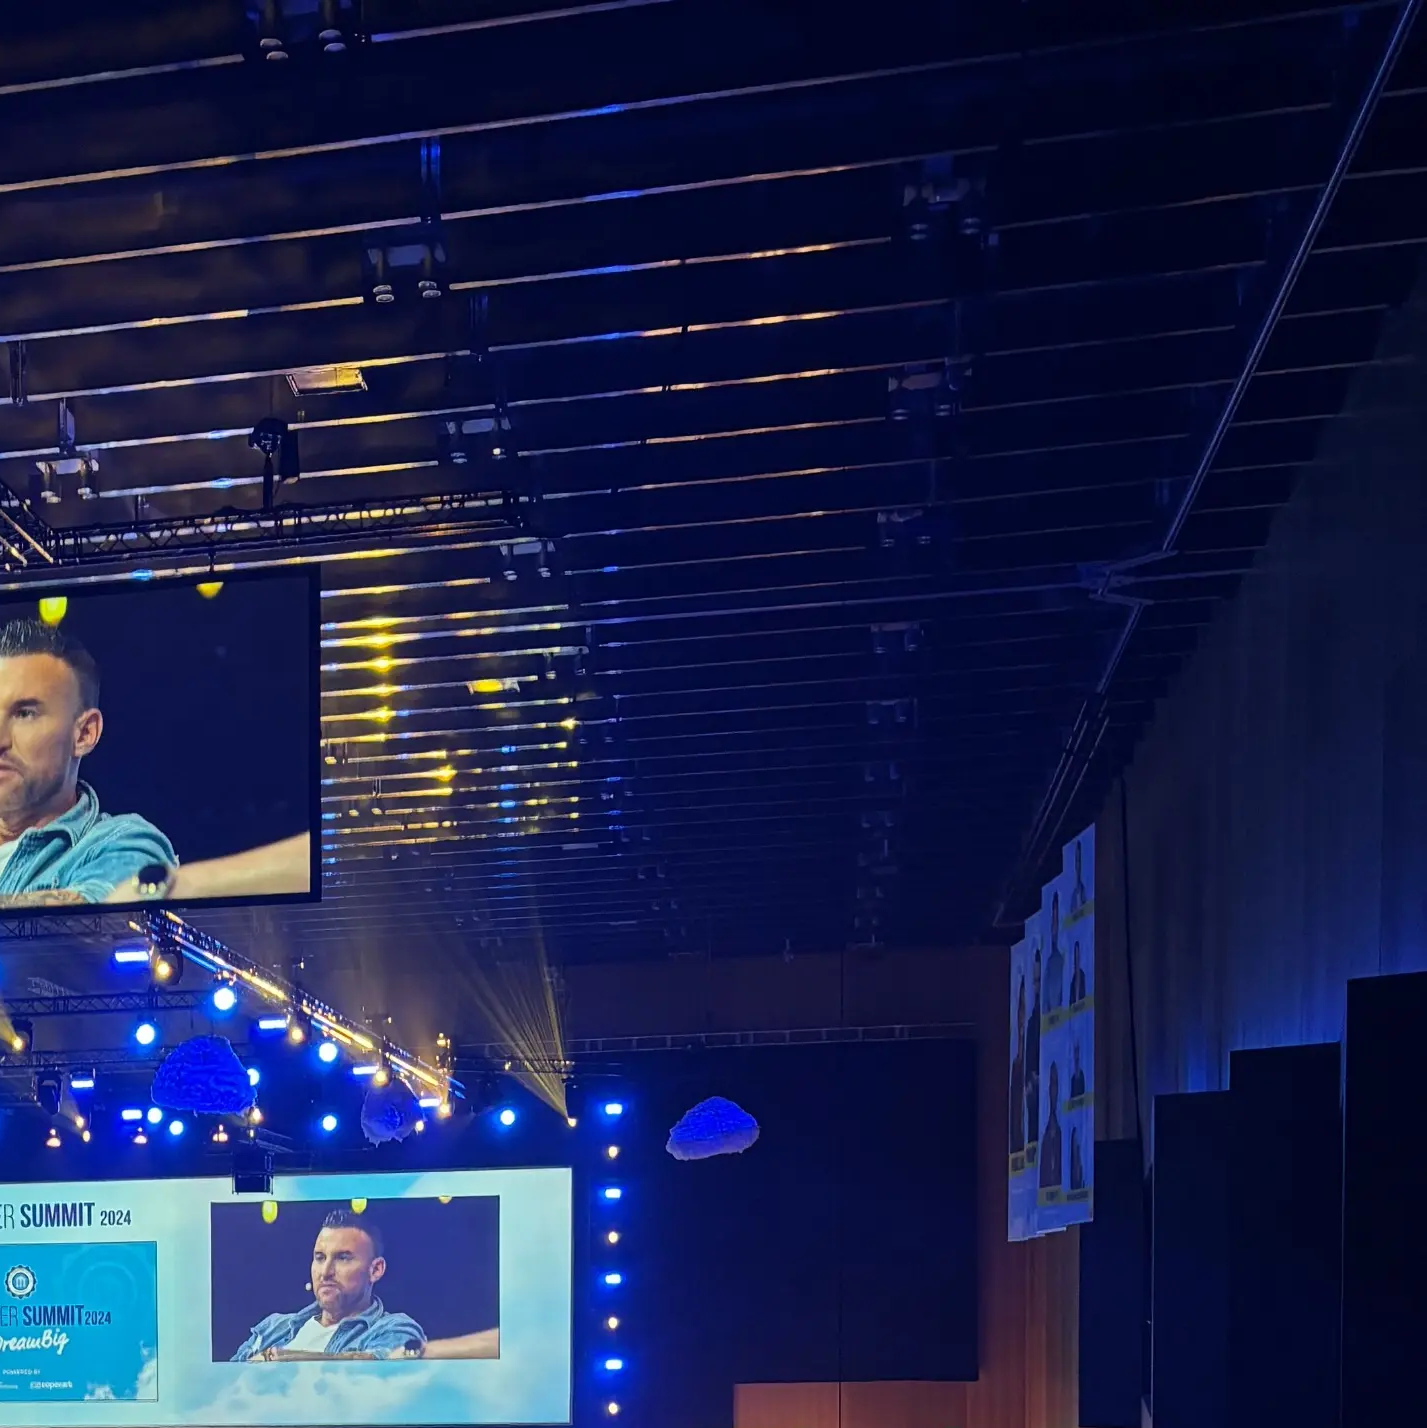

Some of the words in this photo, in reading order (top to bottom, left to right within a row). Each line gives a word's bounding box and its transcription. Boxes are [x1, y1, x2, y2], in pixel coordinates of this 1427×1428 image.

[20, 1202, 95, 1228] SUMMIT
[100, 1210, 132, 1226] 2024
[22, 1304, 85, 1327] SUMMIT
[85, 1311, 112, 1326] 2024
